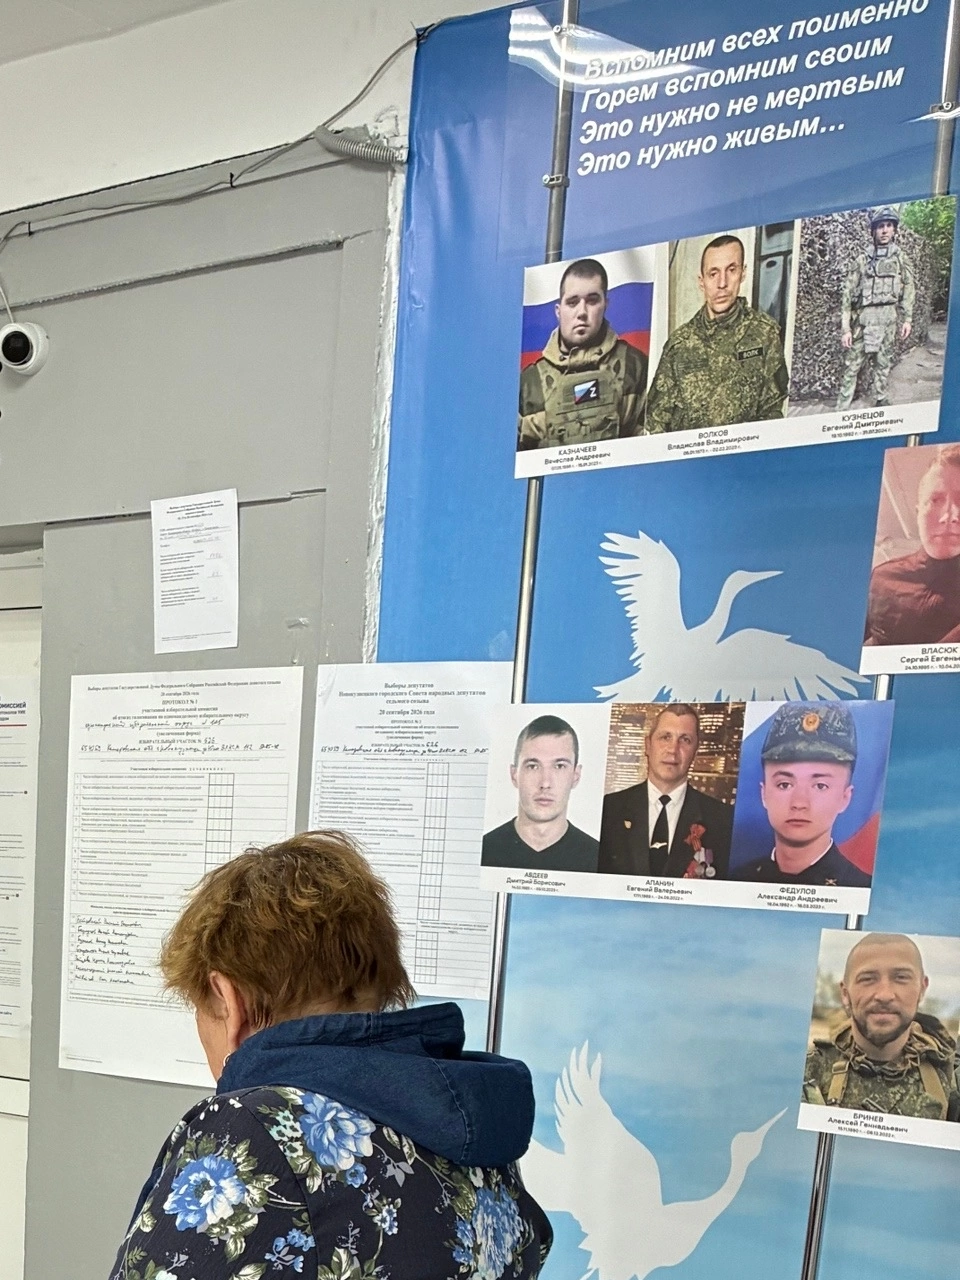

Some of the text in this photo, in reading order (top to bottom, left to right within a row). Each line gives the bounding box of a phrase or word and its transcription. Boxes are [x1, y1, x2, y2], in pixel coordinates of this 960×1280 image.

[584, 0, 929, 80] Вспомним всех поименно
[581, 34, 893, 113] Горем вспомним своим
[578, 67, 905, 145] Это нужно не мертвым
[577, 115, 846, 177] Это нужно живым...
[842, 411, 884, 422] КУЗНЕЦОВ
[822, 418, 904, 432] Евгений Дмитриевич
[698, 430, 728, 439] ВОЛКОВ
[668, 435, 760, 450] Владислав Владимирович
[558, 446, 596, 456] КАЗНАЧЕЕВ
[575, 452, 610, 461] Андреевич
[922, 646, 958, 654] ВЛАСЮК
[900, 656, 929, 664] Сергей
[757, 893, 796, 902] Александр
[853, 1113, 884, 1122] БРИНЕВ
[828, 1117, 908, 1133] Алексей Геннадьевич
